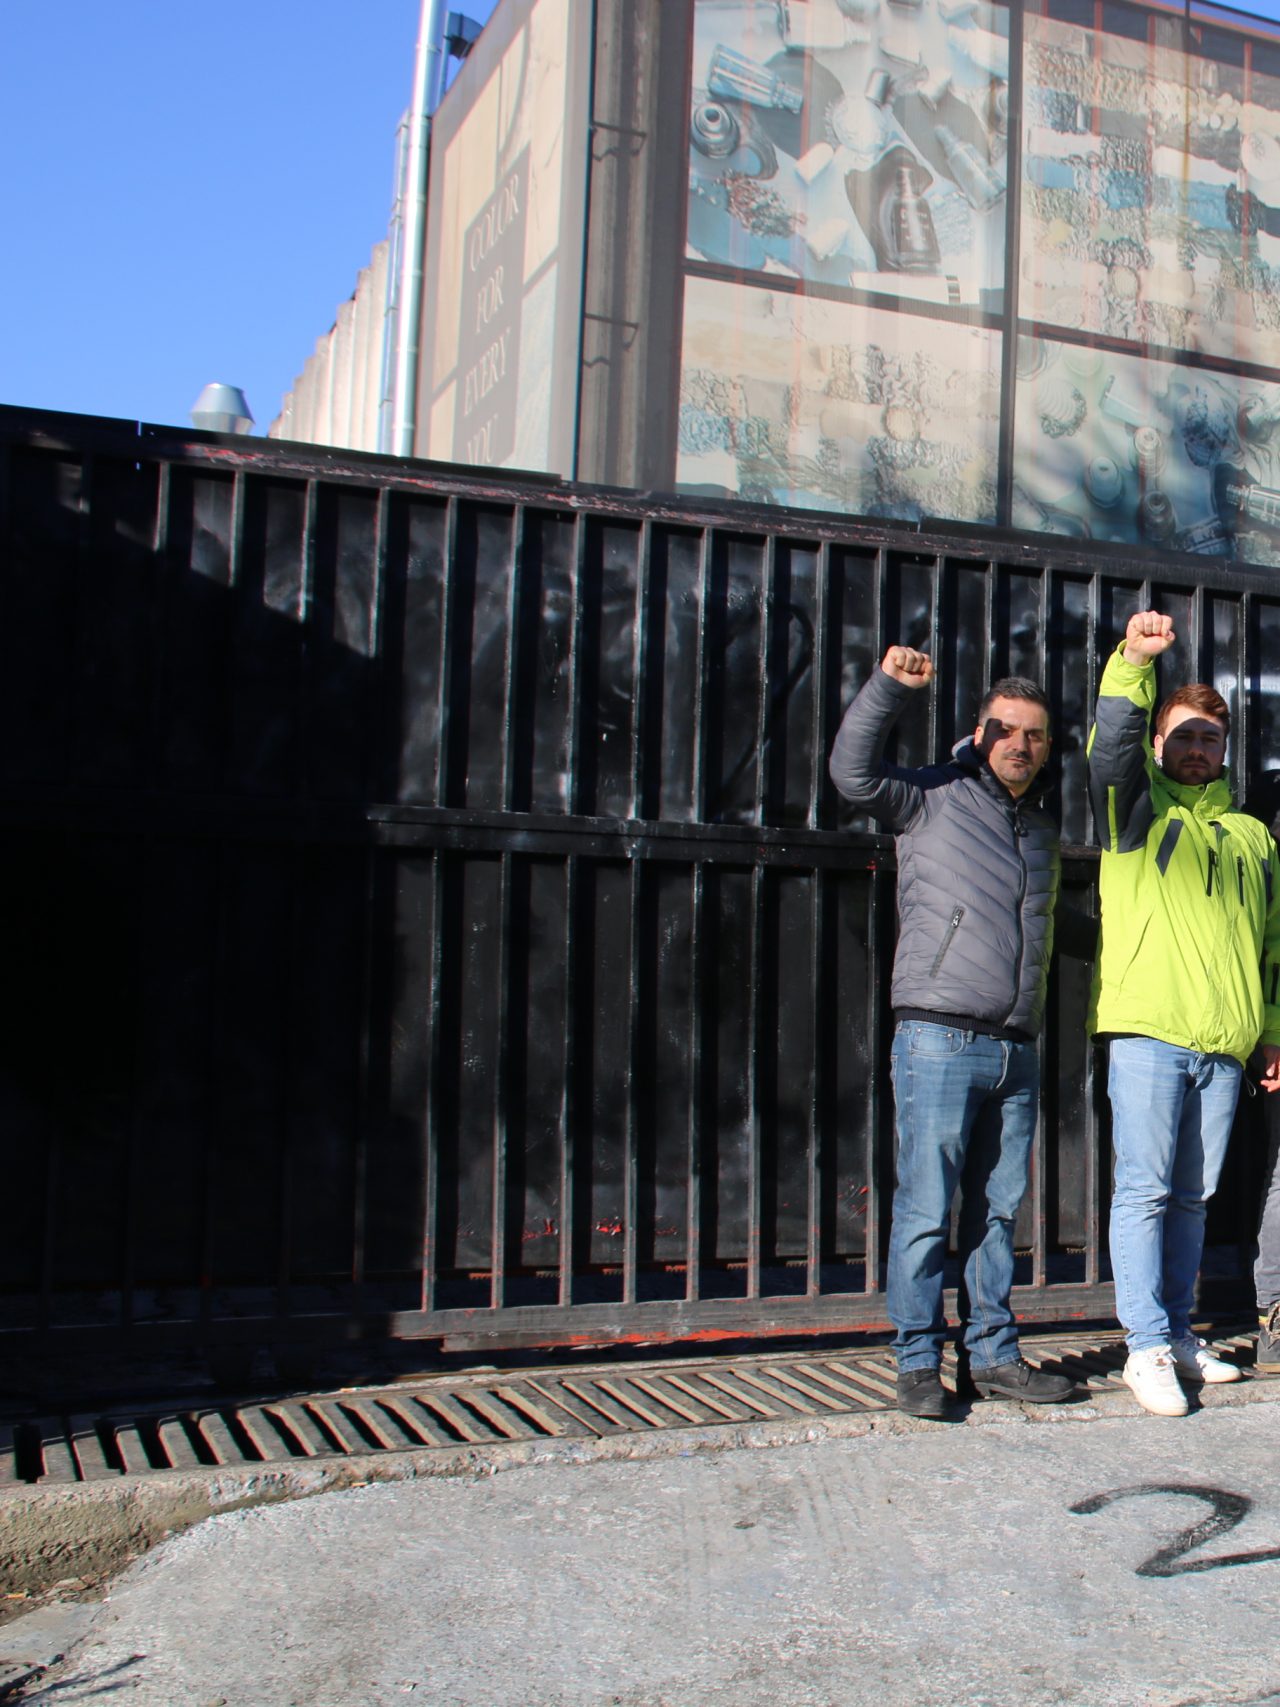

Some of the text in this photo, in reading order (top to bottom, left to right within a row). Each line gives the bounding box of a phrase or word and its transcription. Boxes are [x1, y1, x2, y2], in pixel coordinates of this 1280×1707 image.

[470, 173, 519, 272] COLOR
[476, 265, 504, 334] FOR
[464, 326, 511, 417] EVERY
